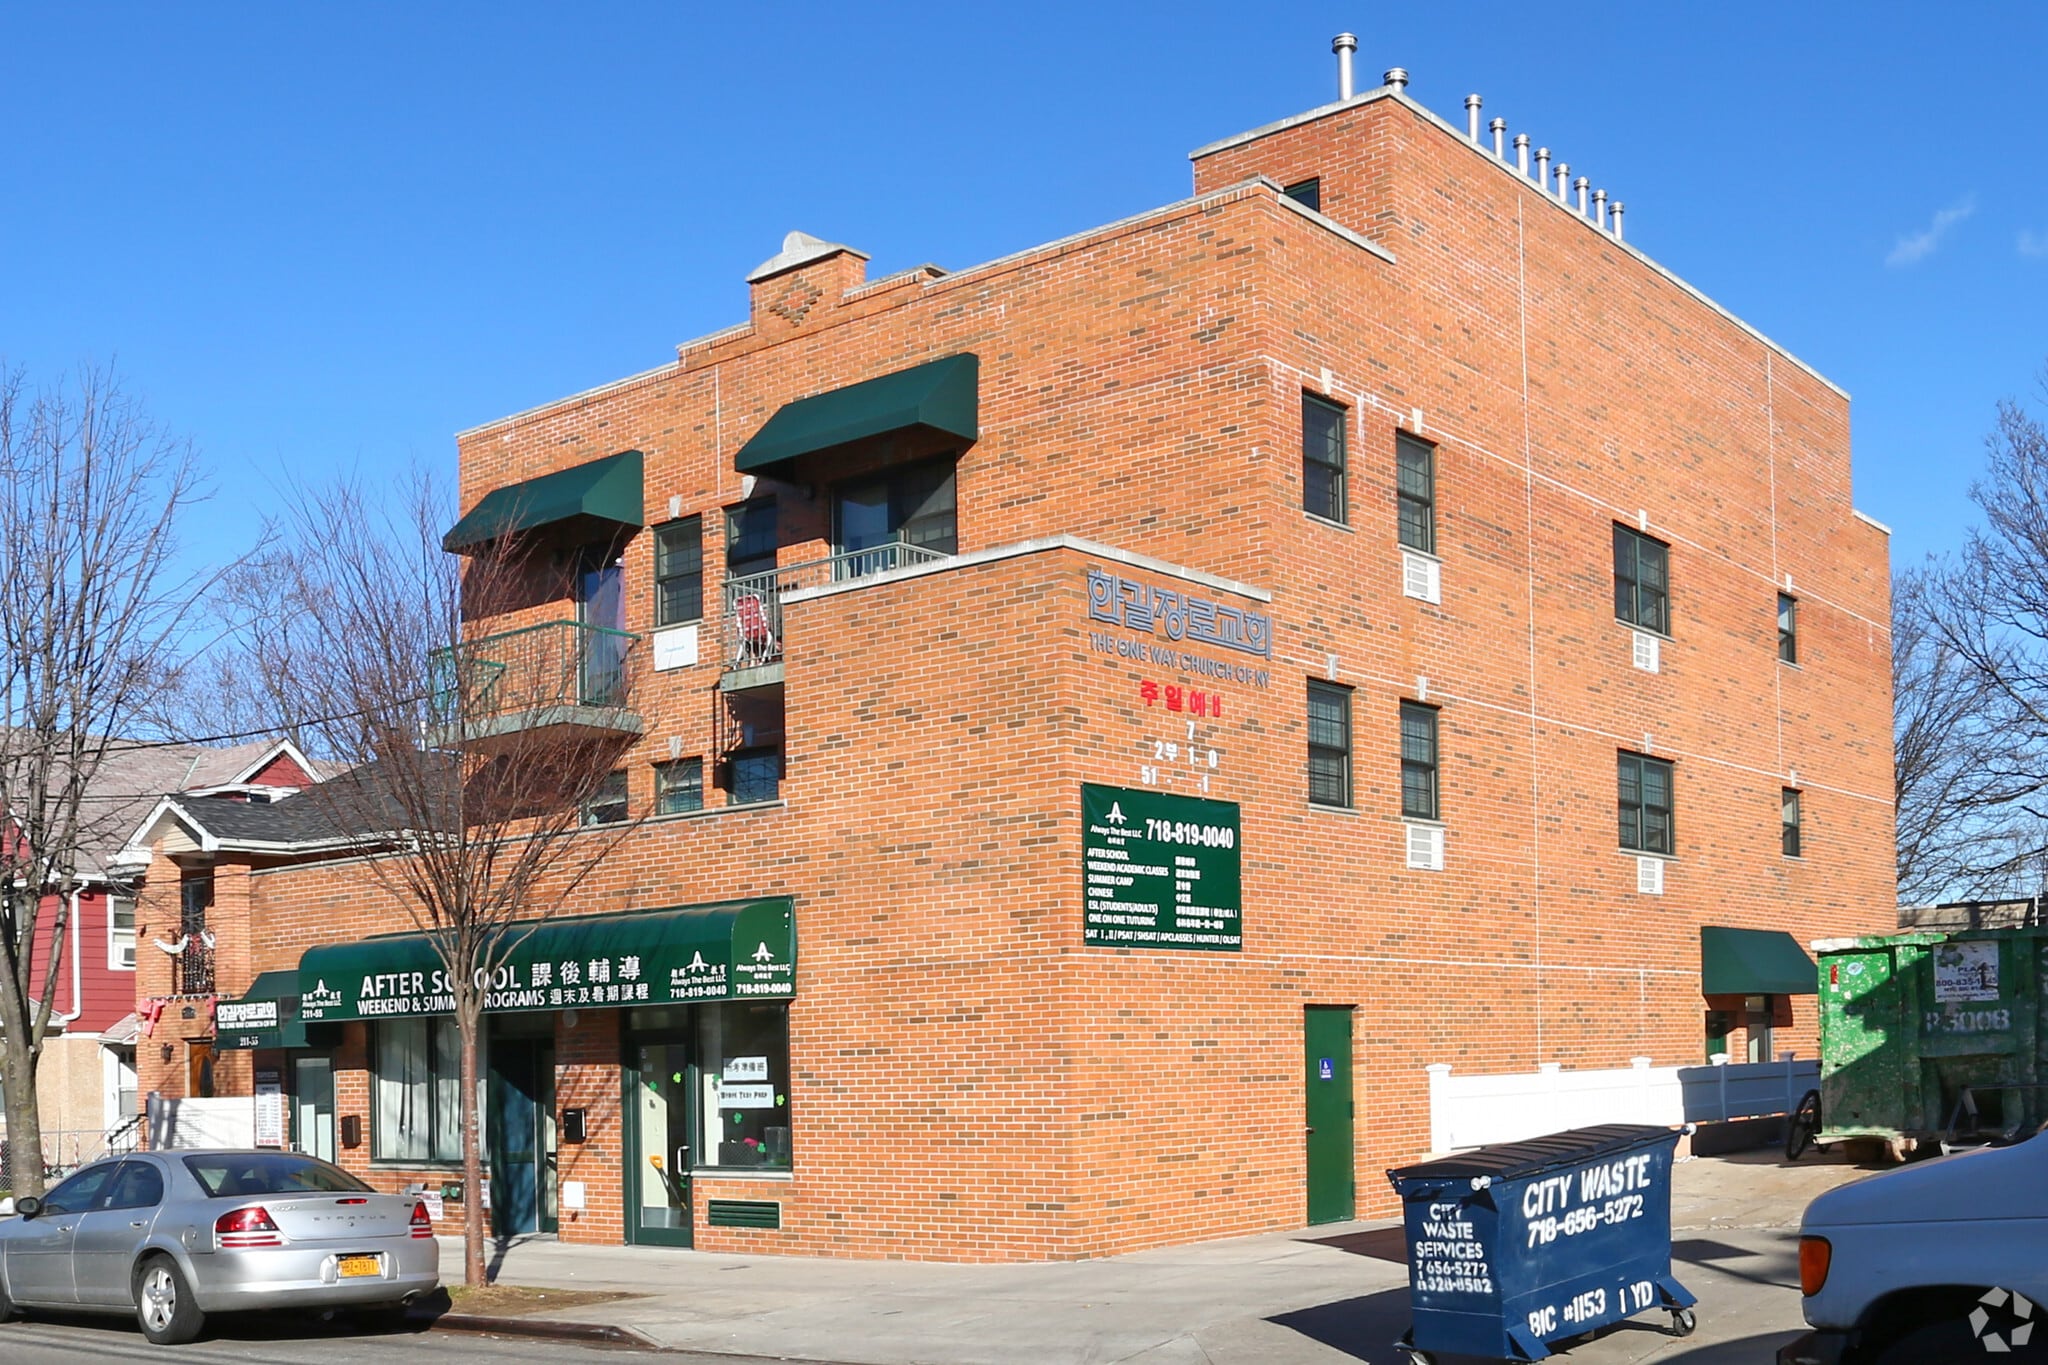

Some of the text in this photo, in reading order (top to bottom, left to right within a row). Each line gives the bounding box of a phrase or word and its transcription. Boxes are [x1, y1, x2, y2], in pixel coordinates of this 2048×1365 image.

[1088, 570, 1272, 660] 한길장로교회
[1089, 632, 1269, 688] THE ONE WAY CHURCH OF NY
[1132, 830, 1142, 838] LLC
[1146, 819, 1234, 848] 718-819-0040
[1087, 848, 1130, 860] AFTER SCHOOL
[1087, 861, 1116, 872] WEEKEND
[1116, 864, 1145, 875] ACADEMIC
[1145, 866, 1169, 876] CLASSES
[1088, 874, 1134, 886] SUMMER CAMP
[1088, 887, 1114, 898] CHINESE
[1088, 900, 1099, 910] ESL
[1088, 913, 1102, 923] ONE
[1102, 914, 1112, 923] ON
[1113, 915, 1126, 924] ONE
[1085, 929, 1098, 939] SAT
[531, 955, 641, 987] 課後輔導
[736, 964, 756, 973] Always
[360, 965, 521, 998] AFTER SCOOL
[715, 974, 726, 982] LLC
[550, 983, 649, 1005] 週末及暑期課程
[670, 985, 727, 998] 718-819-0040
[736, 983, 792, 994] 718-819-0040
[357, 997, 410, 1015] WEEKEND
[412, 1000, 421, 1012] &
[485, 990, 545, 1009] ROGRAMS
[302, 1009, 323, 1018] 211-55
[1523, 1154, 1651, 1218] CITY WASTE
[1528, 1194, 1644, 1248] 718-656-5272
[1423, 1222, 1473, 1239] WASTE
[1416, 1242, 1484, 1259] SERVICES
[1426, 1261, 1488, 1277] 656-5272
[1529, 1280, 1653, 1338] BIC #1153 1 YD
